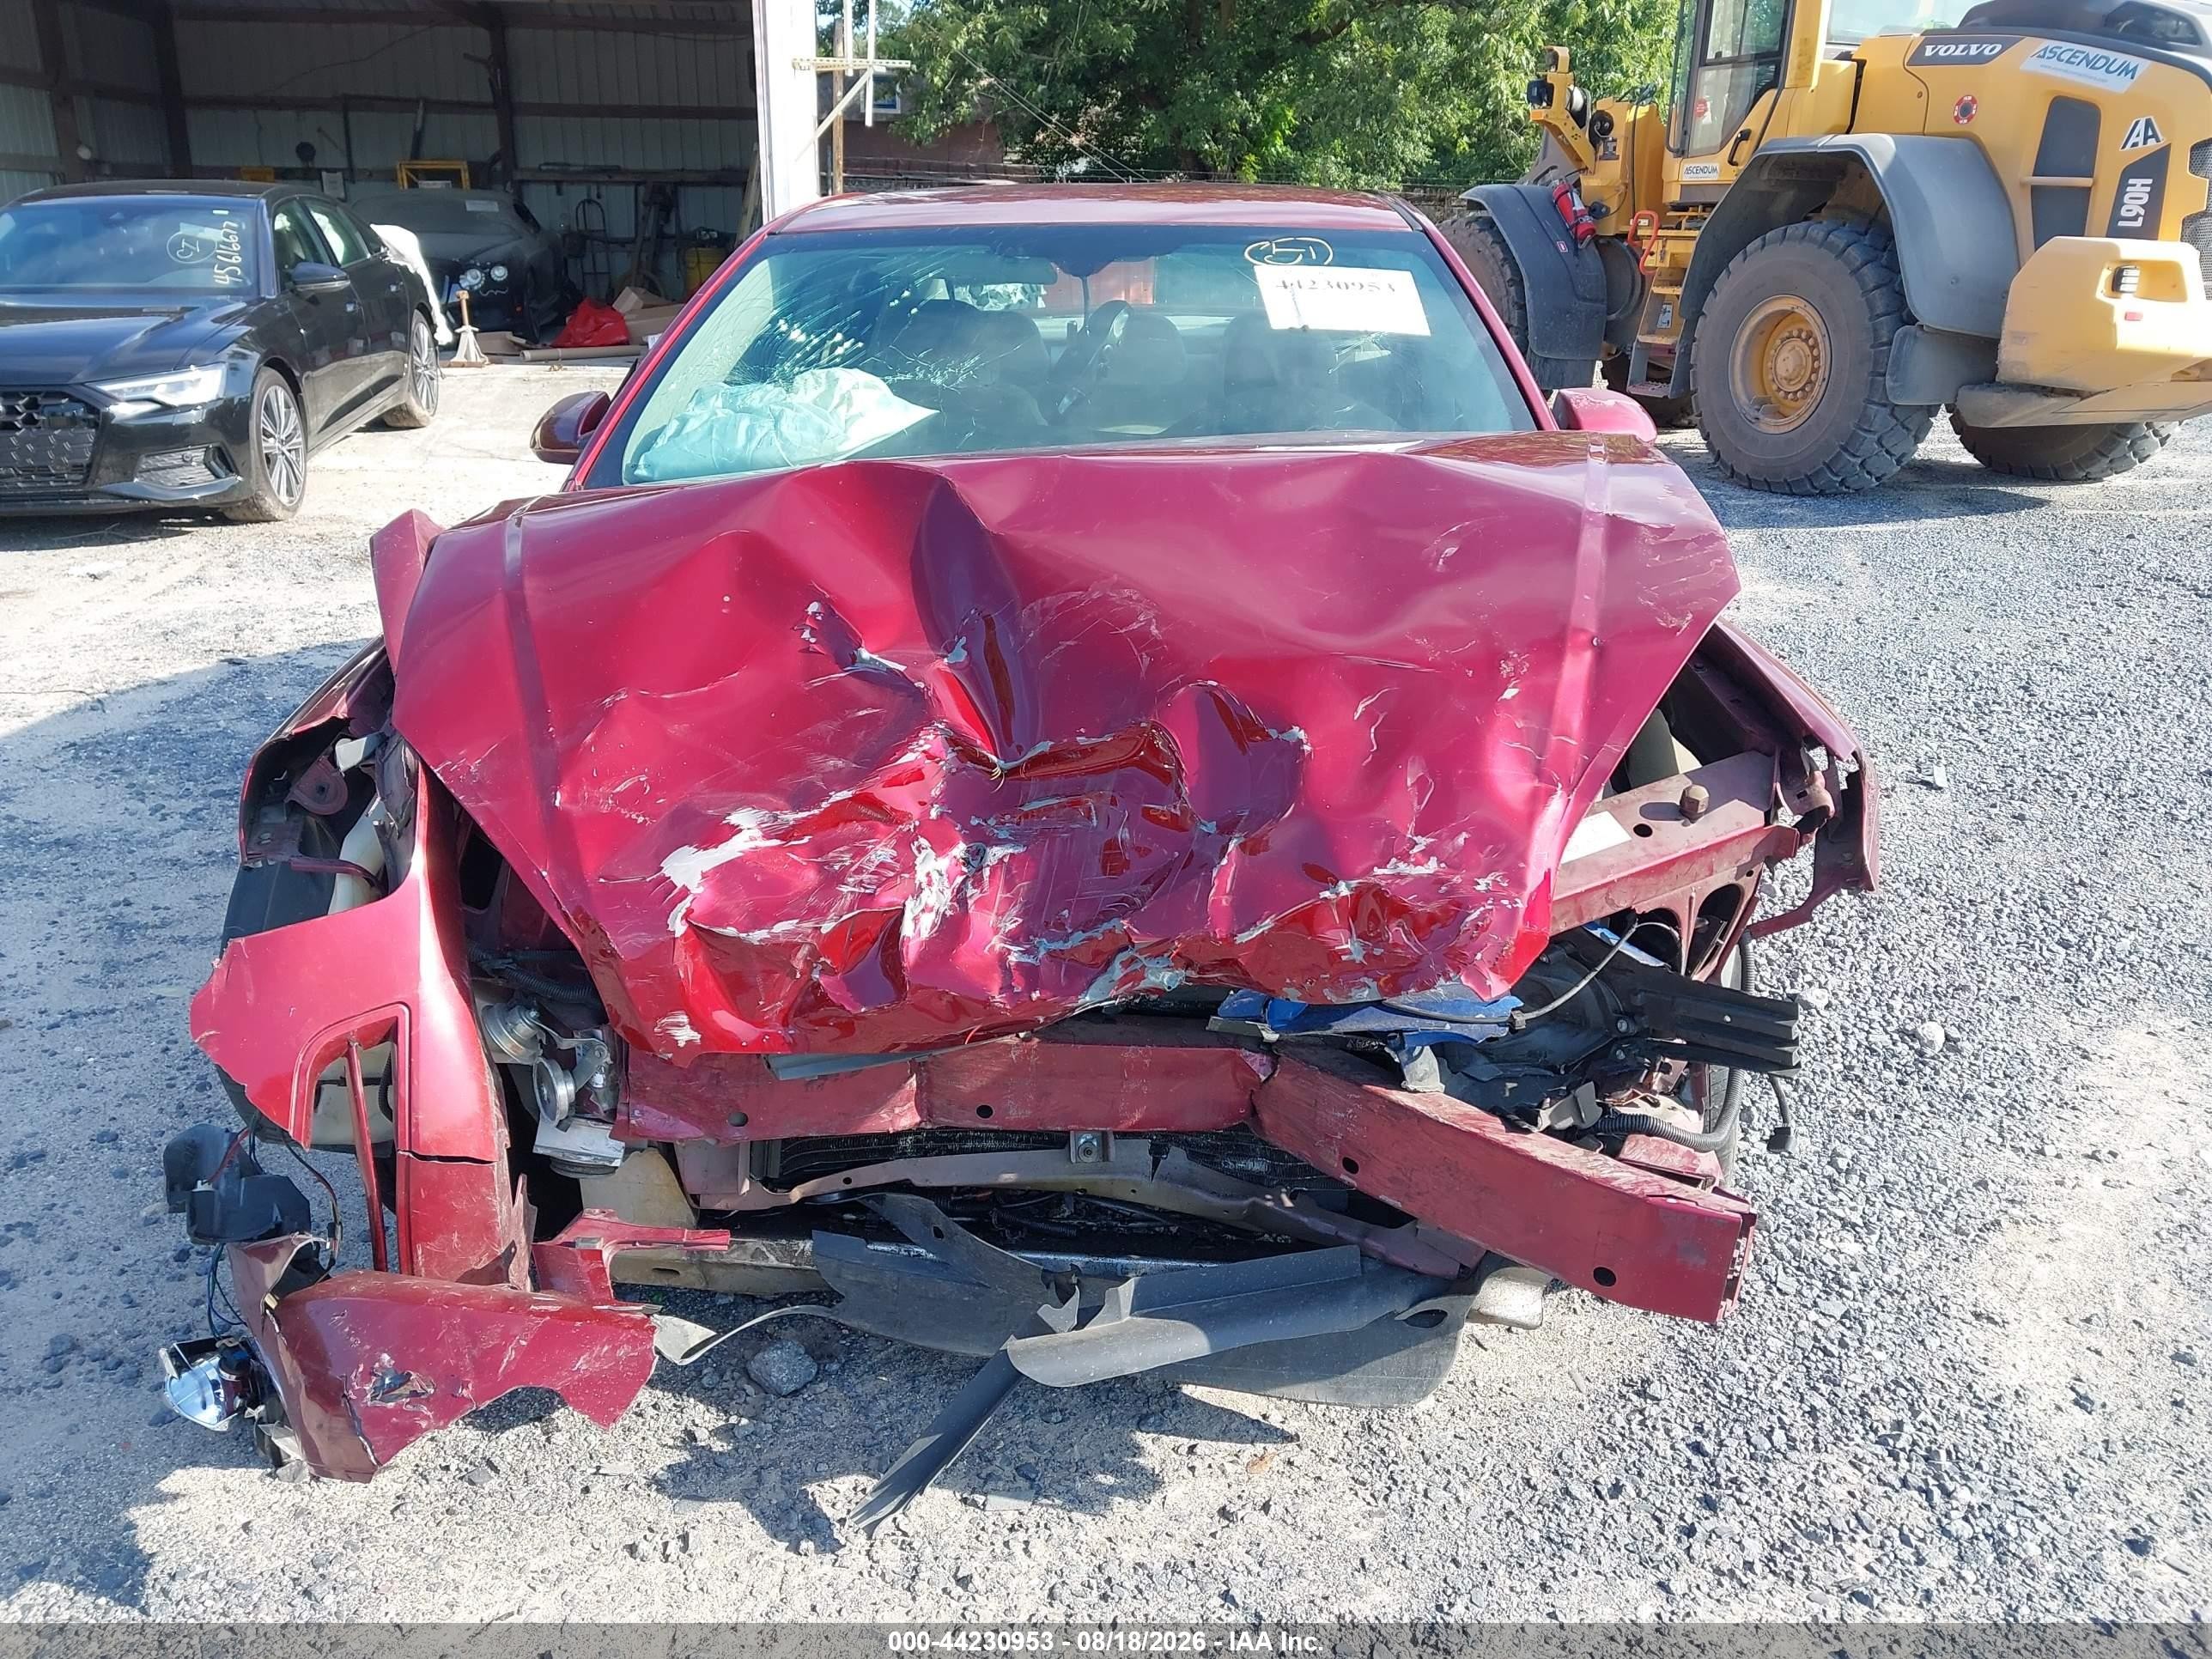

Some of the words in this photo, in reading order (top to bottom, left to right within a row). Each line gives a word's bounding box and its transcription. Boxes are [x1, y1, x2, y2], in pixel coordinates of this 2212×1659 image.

[1924, 43, 2002, 57] VOLVO
[2030, 45, 2140, 80] ASCENDUM
[1683, 165, 1718, 175] ASCENDUM
[2117, 178, 2154, 228] L90H
